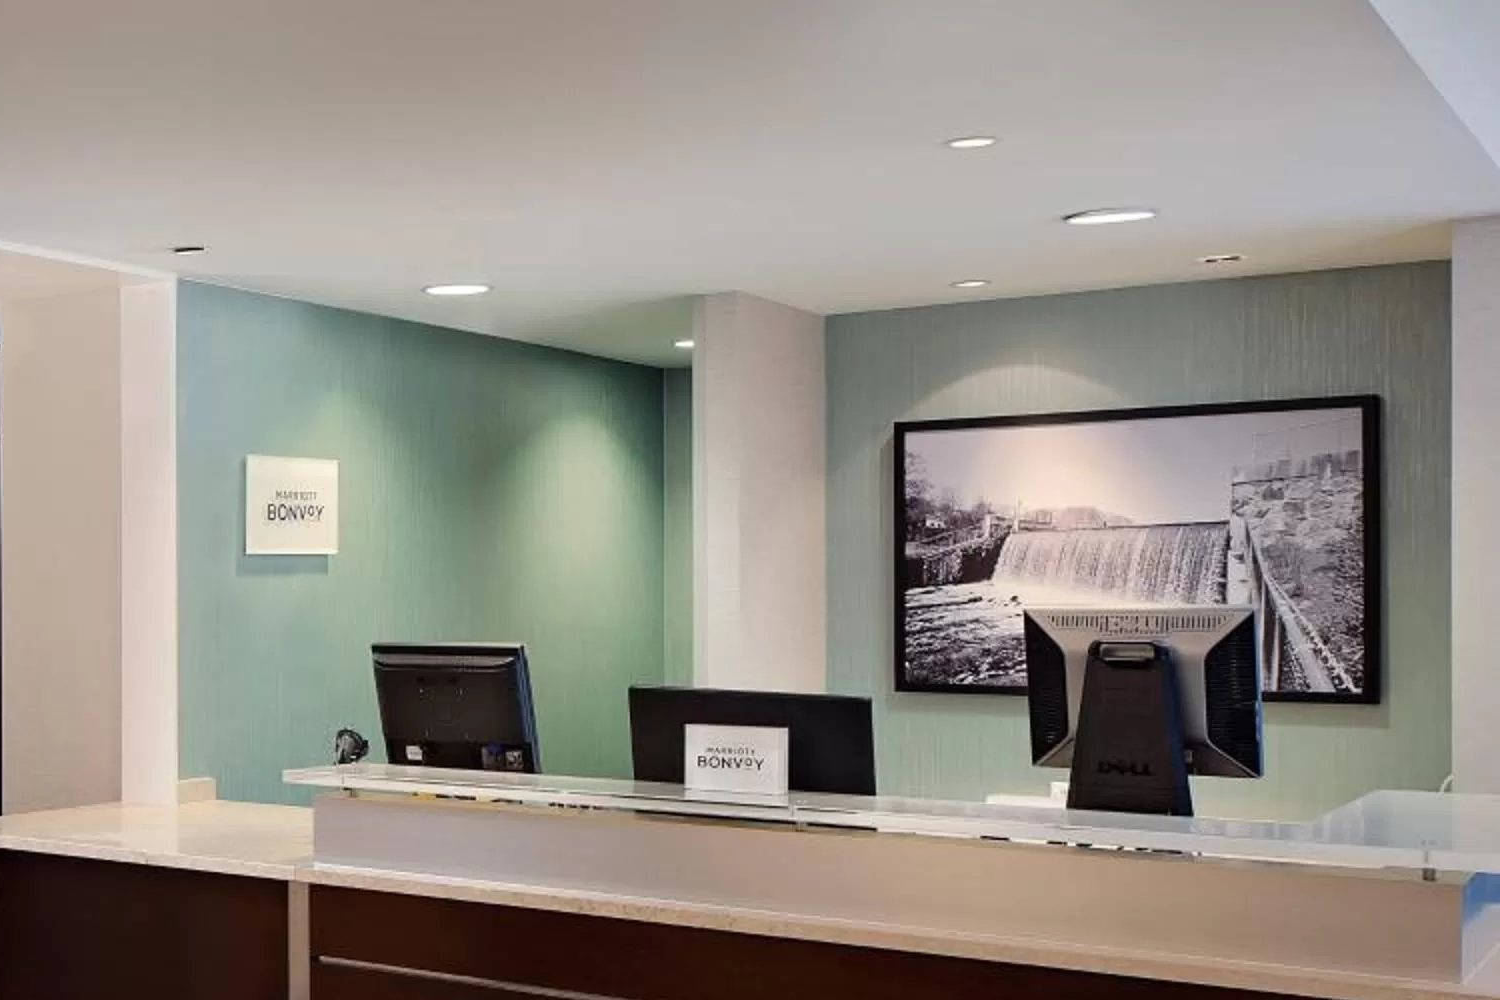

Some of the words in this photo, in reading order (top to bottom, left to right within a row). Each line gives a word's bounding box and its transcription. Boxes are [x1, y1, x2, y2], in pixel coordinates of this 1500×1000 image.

[275, 490, 318, 500] MARRIOTT
[266, 503, 324, 521] BONVOY
[697, 755, 765, 771] BONVOY
